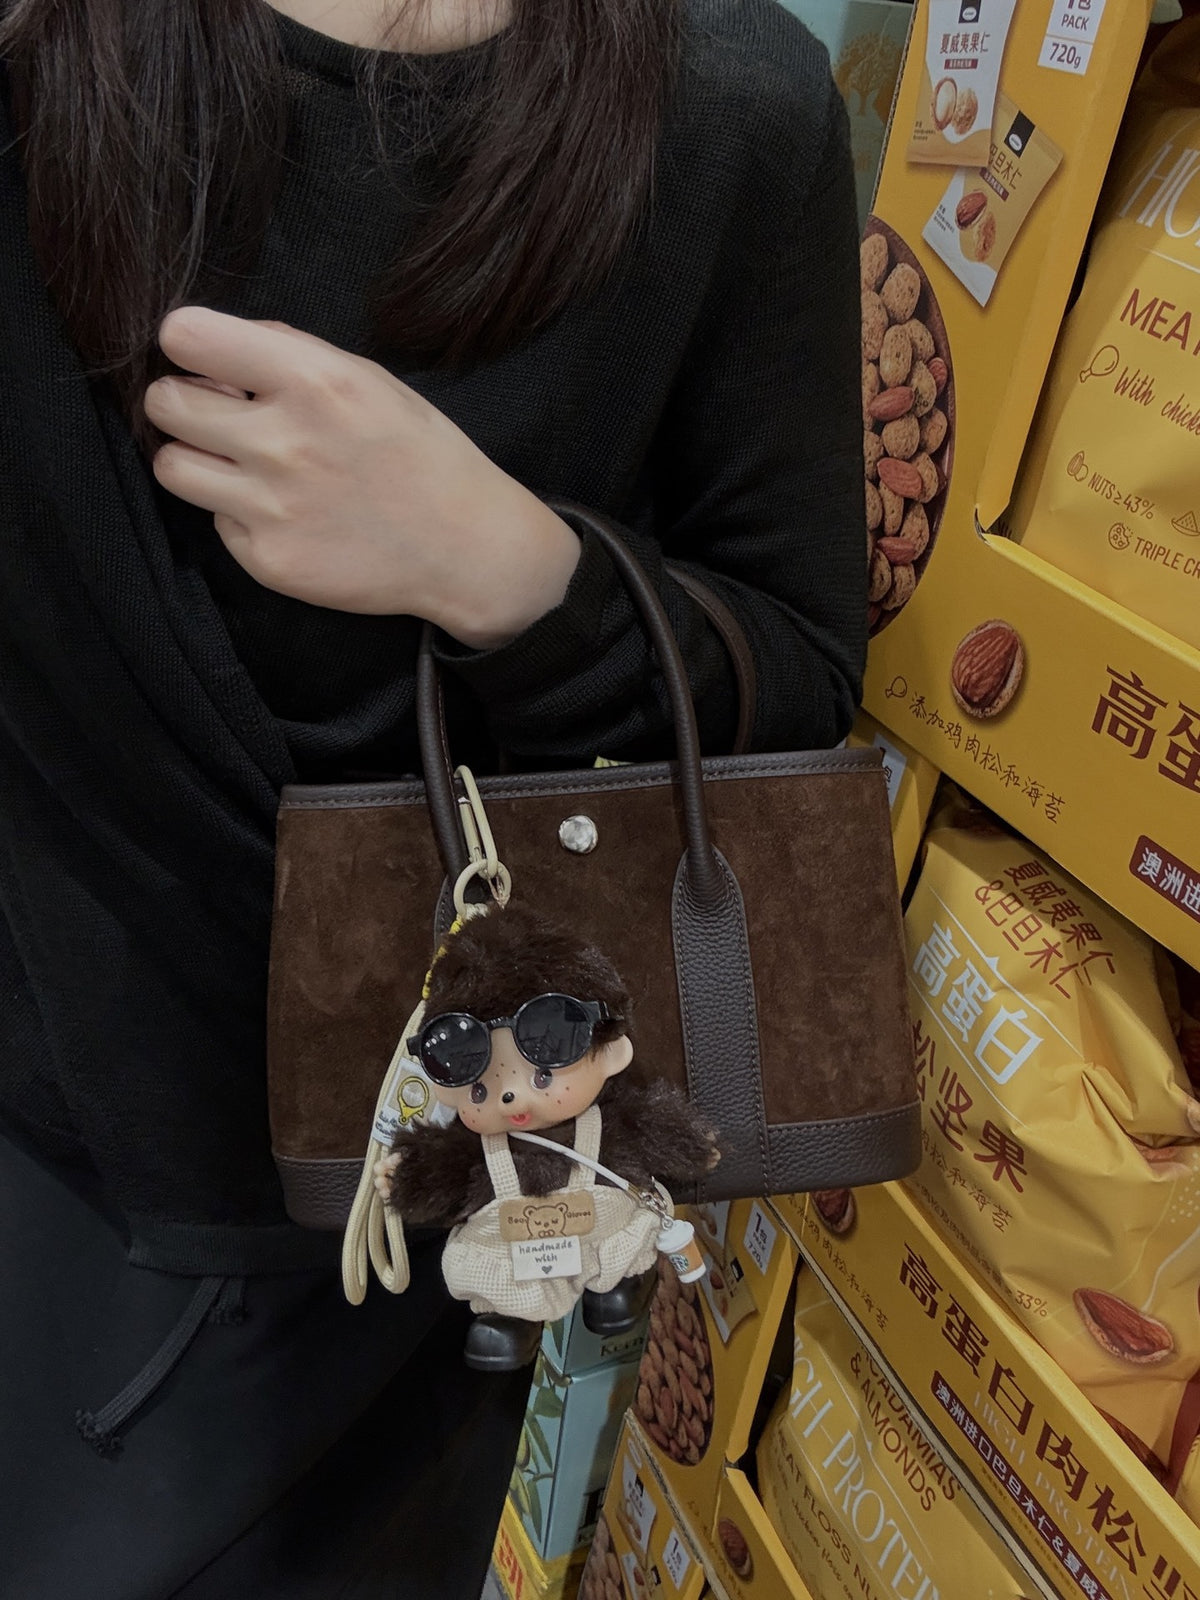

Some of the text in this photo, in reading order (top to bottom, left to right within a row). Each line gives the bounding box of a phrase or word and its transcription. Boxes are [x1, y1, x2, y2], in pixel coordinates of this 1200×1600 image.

[940, 32, 990, 54] 夏威夷果仁
[1049, 42, 1081, 69] 720g
[1061, 13, 1090, 31] PACK
[1119, 288, 1200, 356] MEA
[1114, 366, 1155, 407] With
[1134, 536, 1184, 570] TRIPLE
[909, 692, 1066, 824] 添加鸡肉松和海苔
[1003, 859, 1116, 985] 夏威夷果仁
[912, 921, 1044, 1085] 高蛋白
[519, 1240, 573, 1255] handmade
[535, 1253, 558, 1263] with
[861, 1378, 936, 1511] ALMONDS
[822, 1428, 940, 1600] PROTEI
[935, 1379, 1108, 1600] 澳洲进口巴旦木仁&夏威
[803, 1485, 852, 1564] FLOSS
